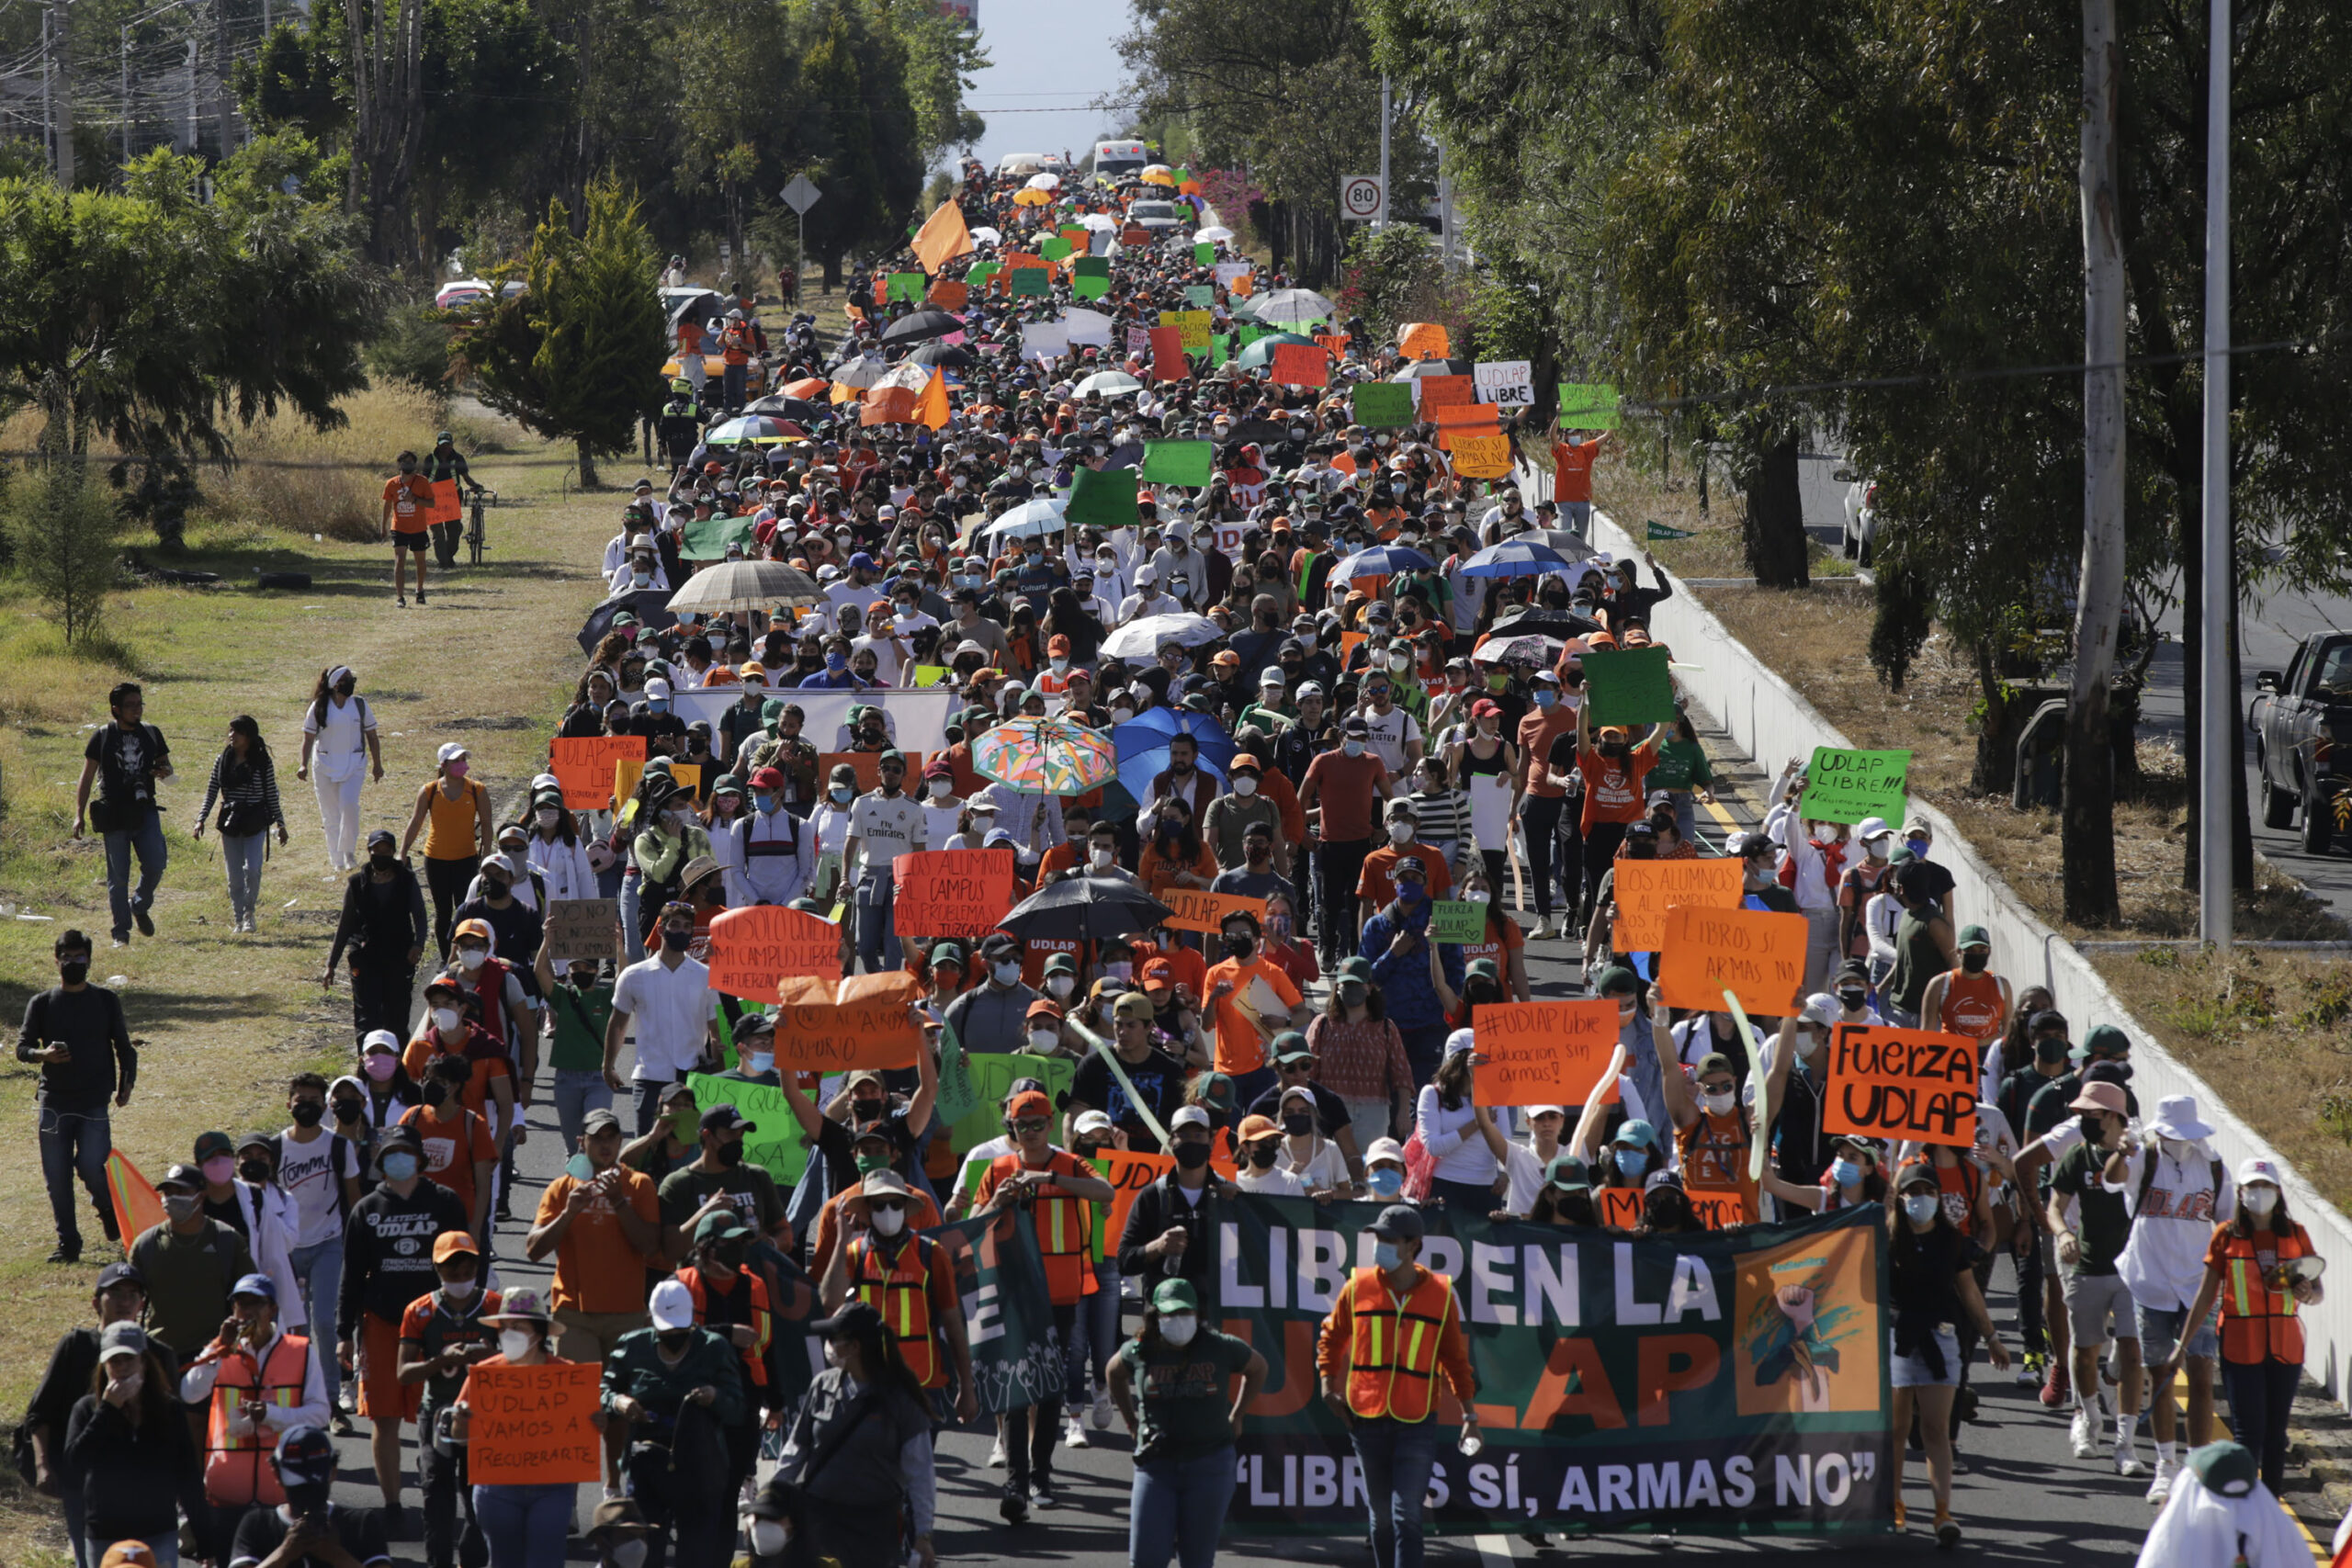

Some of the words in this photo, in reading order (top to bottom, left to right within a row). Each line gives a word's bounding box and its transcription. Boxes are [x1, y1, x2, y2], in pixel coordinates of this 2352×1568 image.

[1353, 187, 1374, 202] 80
[1479, 366, 1527, 387] UDLAP
[1486, 386, 1529, 402] LIBRE
[1452, 437, 1486, 451] LIBROS
[1454, 448, 1487, 464] ARMAS
[1491, 450, 1509, 464] NO
[1021, 582, 1048, 592] Cultural
[1819, 753, 1883, 773] UDLAP
[591, 767, 616, 787] LIB
[1817, 773, 1903, 794] LIBRE!!!
[867, 828, 905, 840] Emirates
[880, 820, 892, 829] Fly
[895, 853, 931, 877] LOS
[939, 851, 1011, 875] ALUMNOS
[1616, 869, 1653, 891] LOS
[1659, 867, 1736, 891] ALUMNOS
[930, 877, 986, 902] CAMPUS
[559, 904, 581, 921] YO
[586, 905, 607, 919] NO
[921, 903, 996, 923] PROBLEMAS
[1163, 895, 1219, 921] #UDLAP
[1638, 895, 1651, 912] AL
[1635, 931, 1659, 946] LOS
[1682, 911, 1751, 952] LIBROS
[1030, 939, 1076, 951] UDLAP
[1463, 942, 1498, 954] UDLAP
[714, 945, 735, 966] MI
[739, 945, 797, 967] CAMPUS
[799, 945, 838, 967] LIBRE
[1705, 956, 1762, 984] ARMAS
[1774, 961, 1795, 982] NO
[1498, 1061, 1561, 1085] armas!
[1842, 1082, 1976, 1137] UDLAP
[279, 1154, 333, 1191] tommy
[376, 1221, 438, 1237] UDLAP
[1219, 1223, 1581, 1326] LIBREN
[1614, 1246, 1722, 1325] LA
[475, 1370, 586, 1390] RESISTE
[480, 1392, 569, 1413] UDLAP
[479, 1419, 554, 1439] VAMOS
[565, 1416, 579, 1433] A
[477, 1446, 595, 1469] RECUPERARTE
[1237, 1454, 1451, 1507] "LIBRS
[1557, 1454, 1756, 1513] ARMAS
